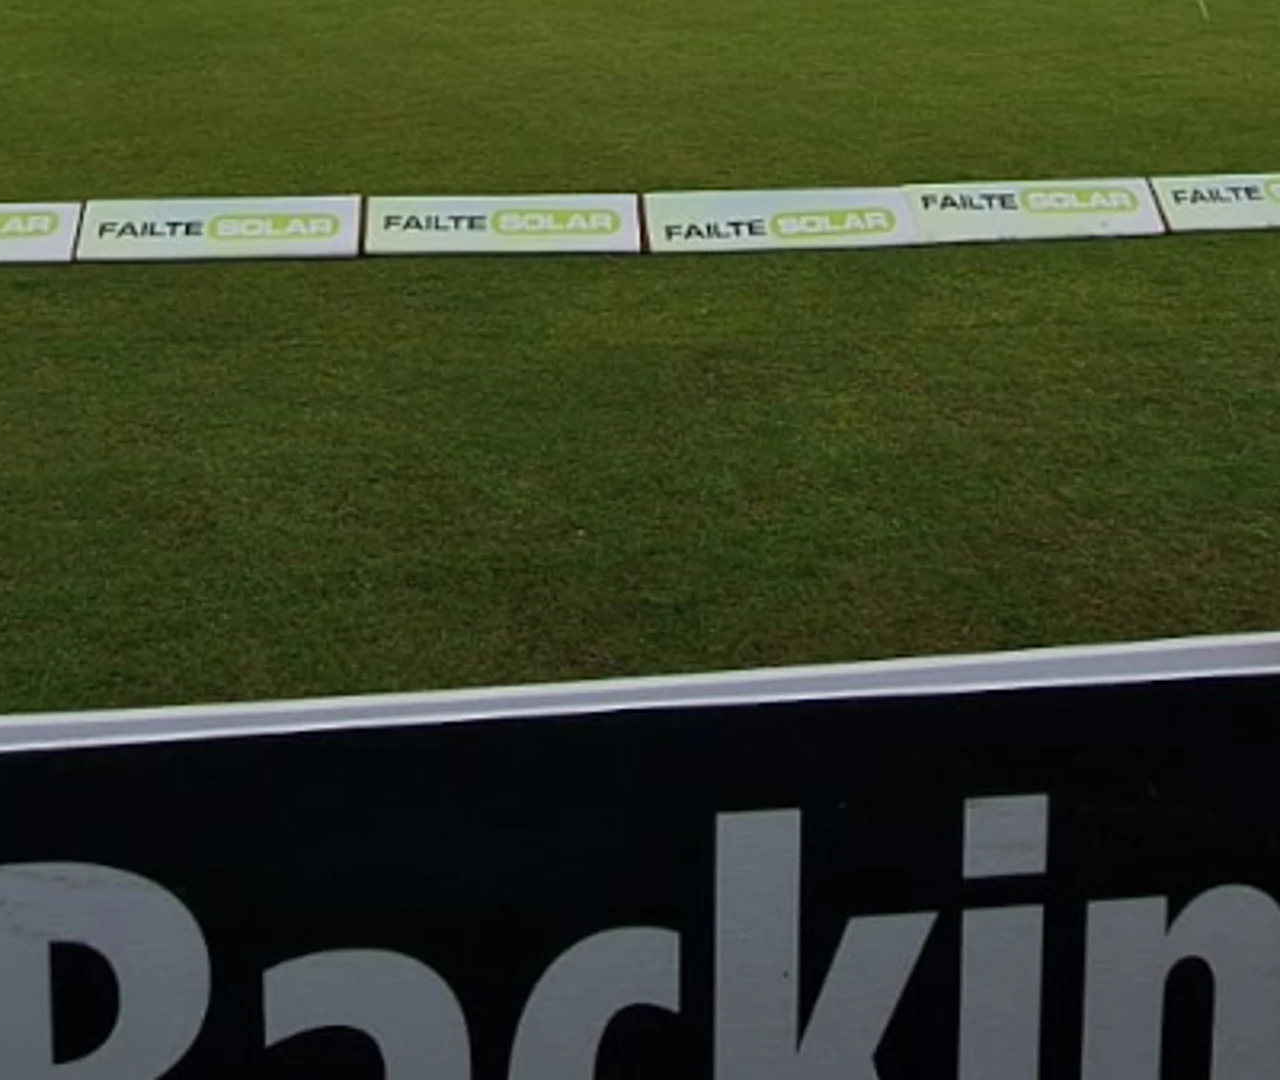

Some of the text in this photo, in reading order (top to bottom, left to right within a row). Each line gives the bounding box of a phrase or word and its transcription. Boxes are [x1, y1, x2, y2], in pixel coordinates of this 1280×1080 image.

[922, 191, 1135, 211] FAILTE SOLAR
[1172, 186, 1263, 205] FAILTE
[98, 217, 334, 239] FAILTE SOLAR
[384, 212, 615, 232] FAILTE SOLAR
[665, 213, 891, 241] FAILTE SOLAR
